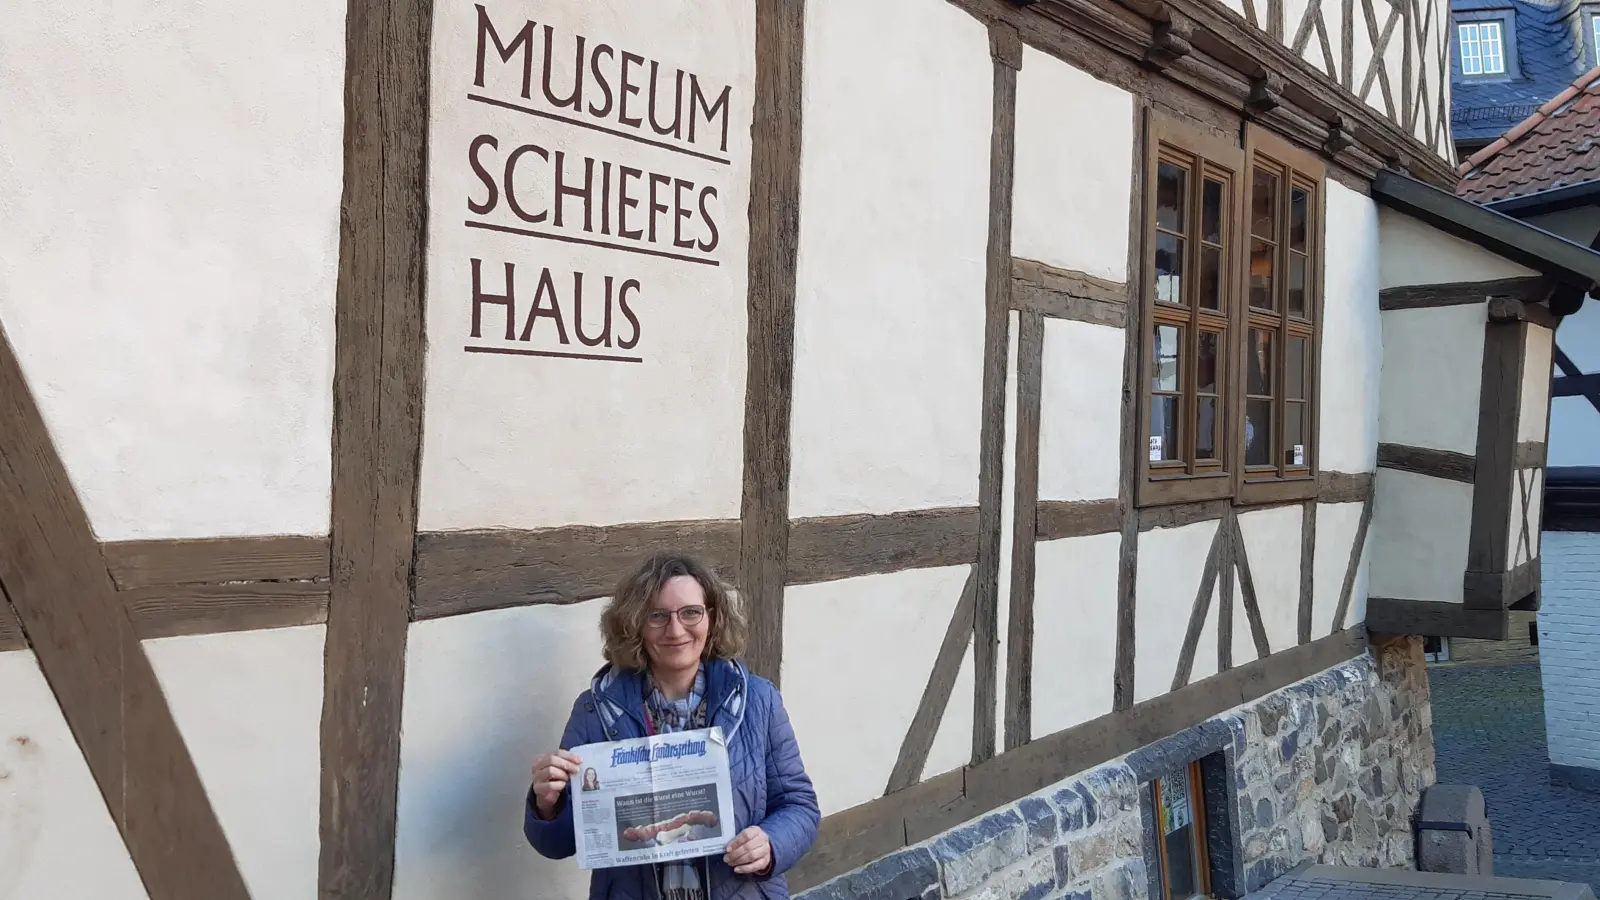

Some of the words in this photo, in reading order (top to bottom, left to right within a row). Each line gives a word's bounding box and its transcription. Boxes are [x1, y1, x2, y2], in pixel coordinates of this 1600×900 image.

[473, 3, 732, 152] MUSEUM
[467, 134, 720, 253] SCHIEFES
[469, 258, 641, 350] HAUS
[650, 739, 707, 763] Landeszeitung
[616, 799, 635, 807] Wann
[635, 796, 643, 804] ist
[653, 793, 671, 802] Wurst
[671, 792, 685, 800] eine
[685, 788, 706, 797] Wurst?
[659, 850, 674, 859] Kraft
